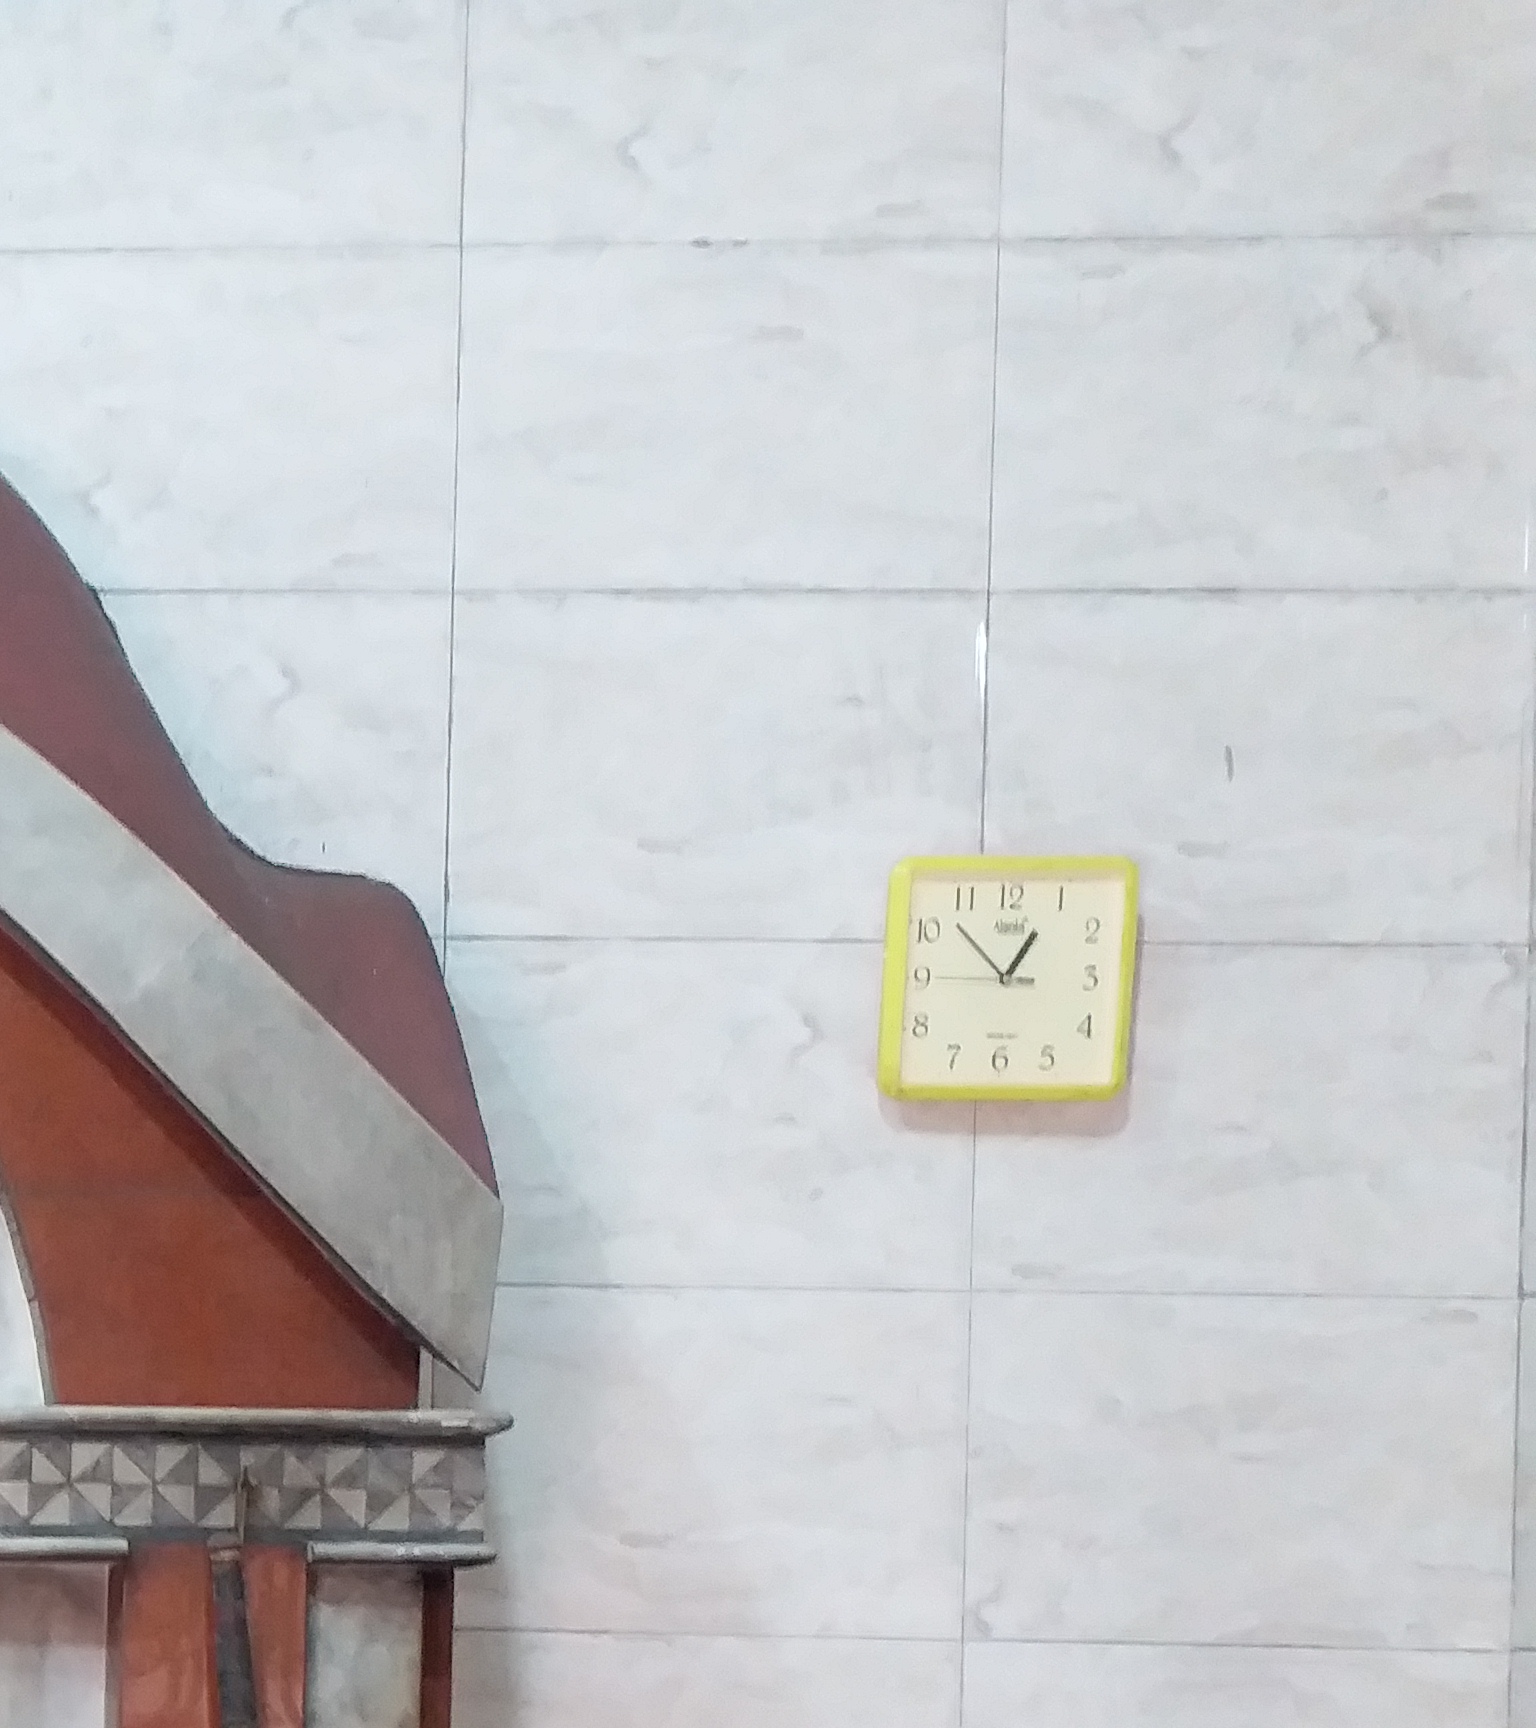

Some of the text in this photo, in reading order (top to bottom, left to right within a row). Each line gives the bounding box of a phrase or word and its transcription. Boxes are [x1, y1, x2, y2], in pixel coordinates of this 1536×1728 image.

[956, 884, 975, 912] 11
[1000, 882, 1025, 911] 12
[1057, 885, 1065, 912] 1
[915, 917, 941, 945] 10
[1084, 917, 1101, 945] 2
[914, 967, 931, 992] 9
[1082, 965, 1099, 992] 3
[912, 1013, 929, 1039] 8
[1076, 1013, 1093, 1040] 4
[946, 1044, 962, 1070] 7
[991, 1045, 1009, 1073] 6
[1038, 1045, 1055, 1072] 5
